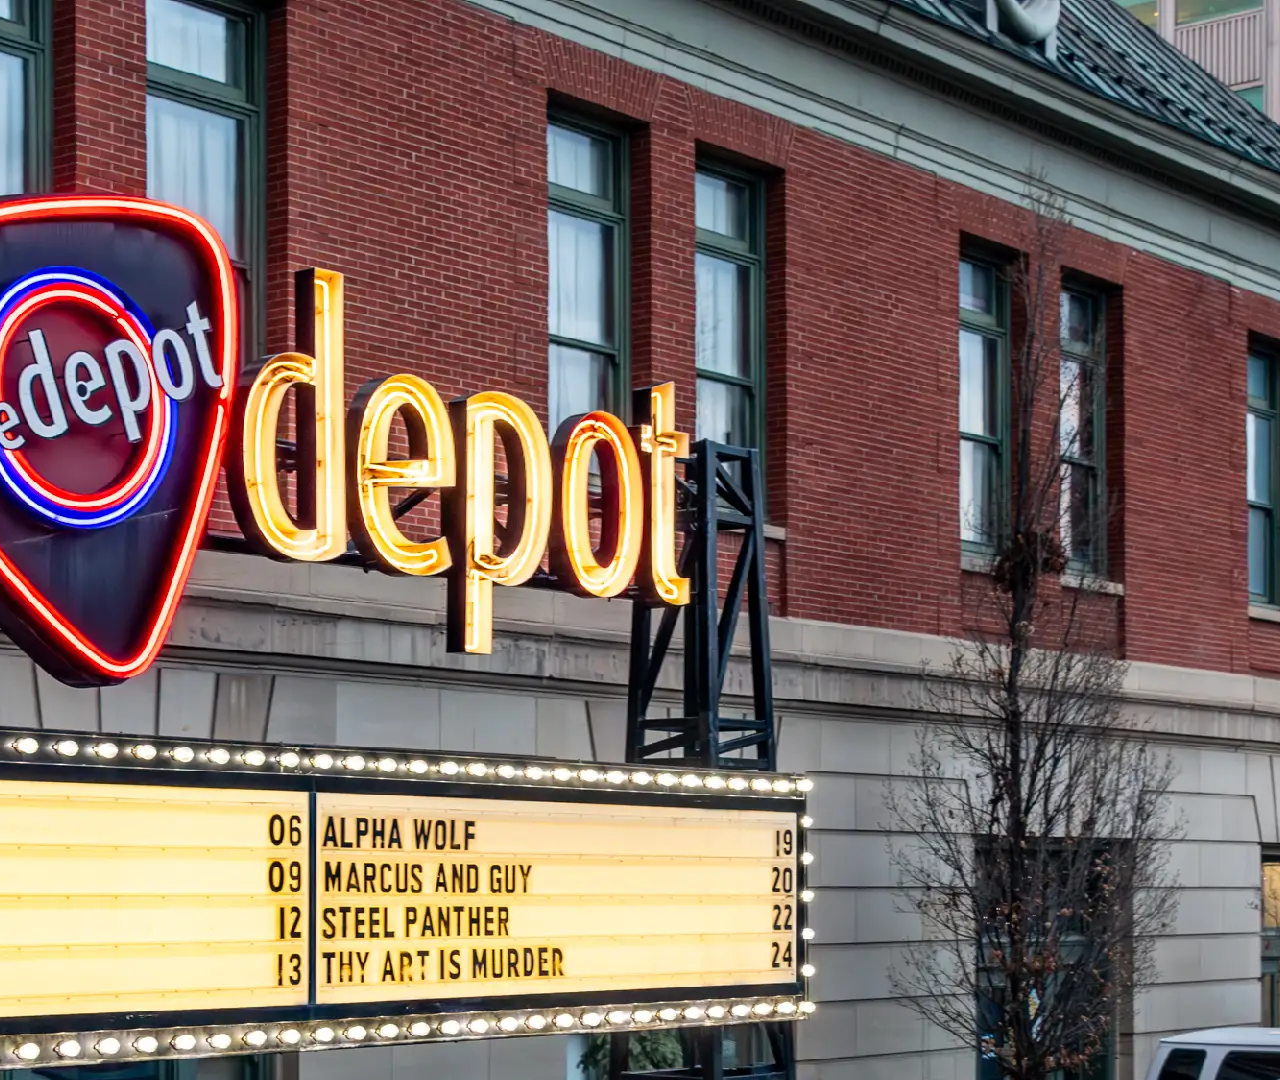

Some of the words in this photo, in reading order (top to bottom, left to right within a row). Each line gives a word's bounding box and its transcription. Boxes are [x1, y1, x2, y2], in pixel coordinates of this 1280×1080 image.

[18, 300, 224, 443] depot
[228, 266, 692, 656] depot
[268, 813, 301, 846] 06
[322, 815, 403, 850] ALPHA
[413, 818, 477, 851] WOLF
[774, 829, 793, 857] 19
[267, 859, 301, 892] 09
[323, 862, 423, 894] MARCUS
[434, 864, 480, 894] AND
[488, 864, 533, 895] GUY
[771, 866, 793, 895] 20
[278, 906, 301, 938] 12
[322, 906, 395, 940] STEEL
[405, 906, 510, 937] PANTHER
[772, 903, 793, 931] 22
[277, 953, 301, 985] 13
[322, 951, 370, 984] THY
[380, 950, 430, 982] ART
[439, 949, 461, 980] IS
[472, 946, 565, 979] MURDER
[771, 941, 793, 969] 24
